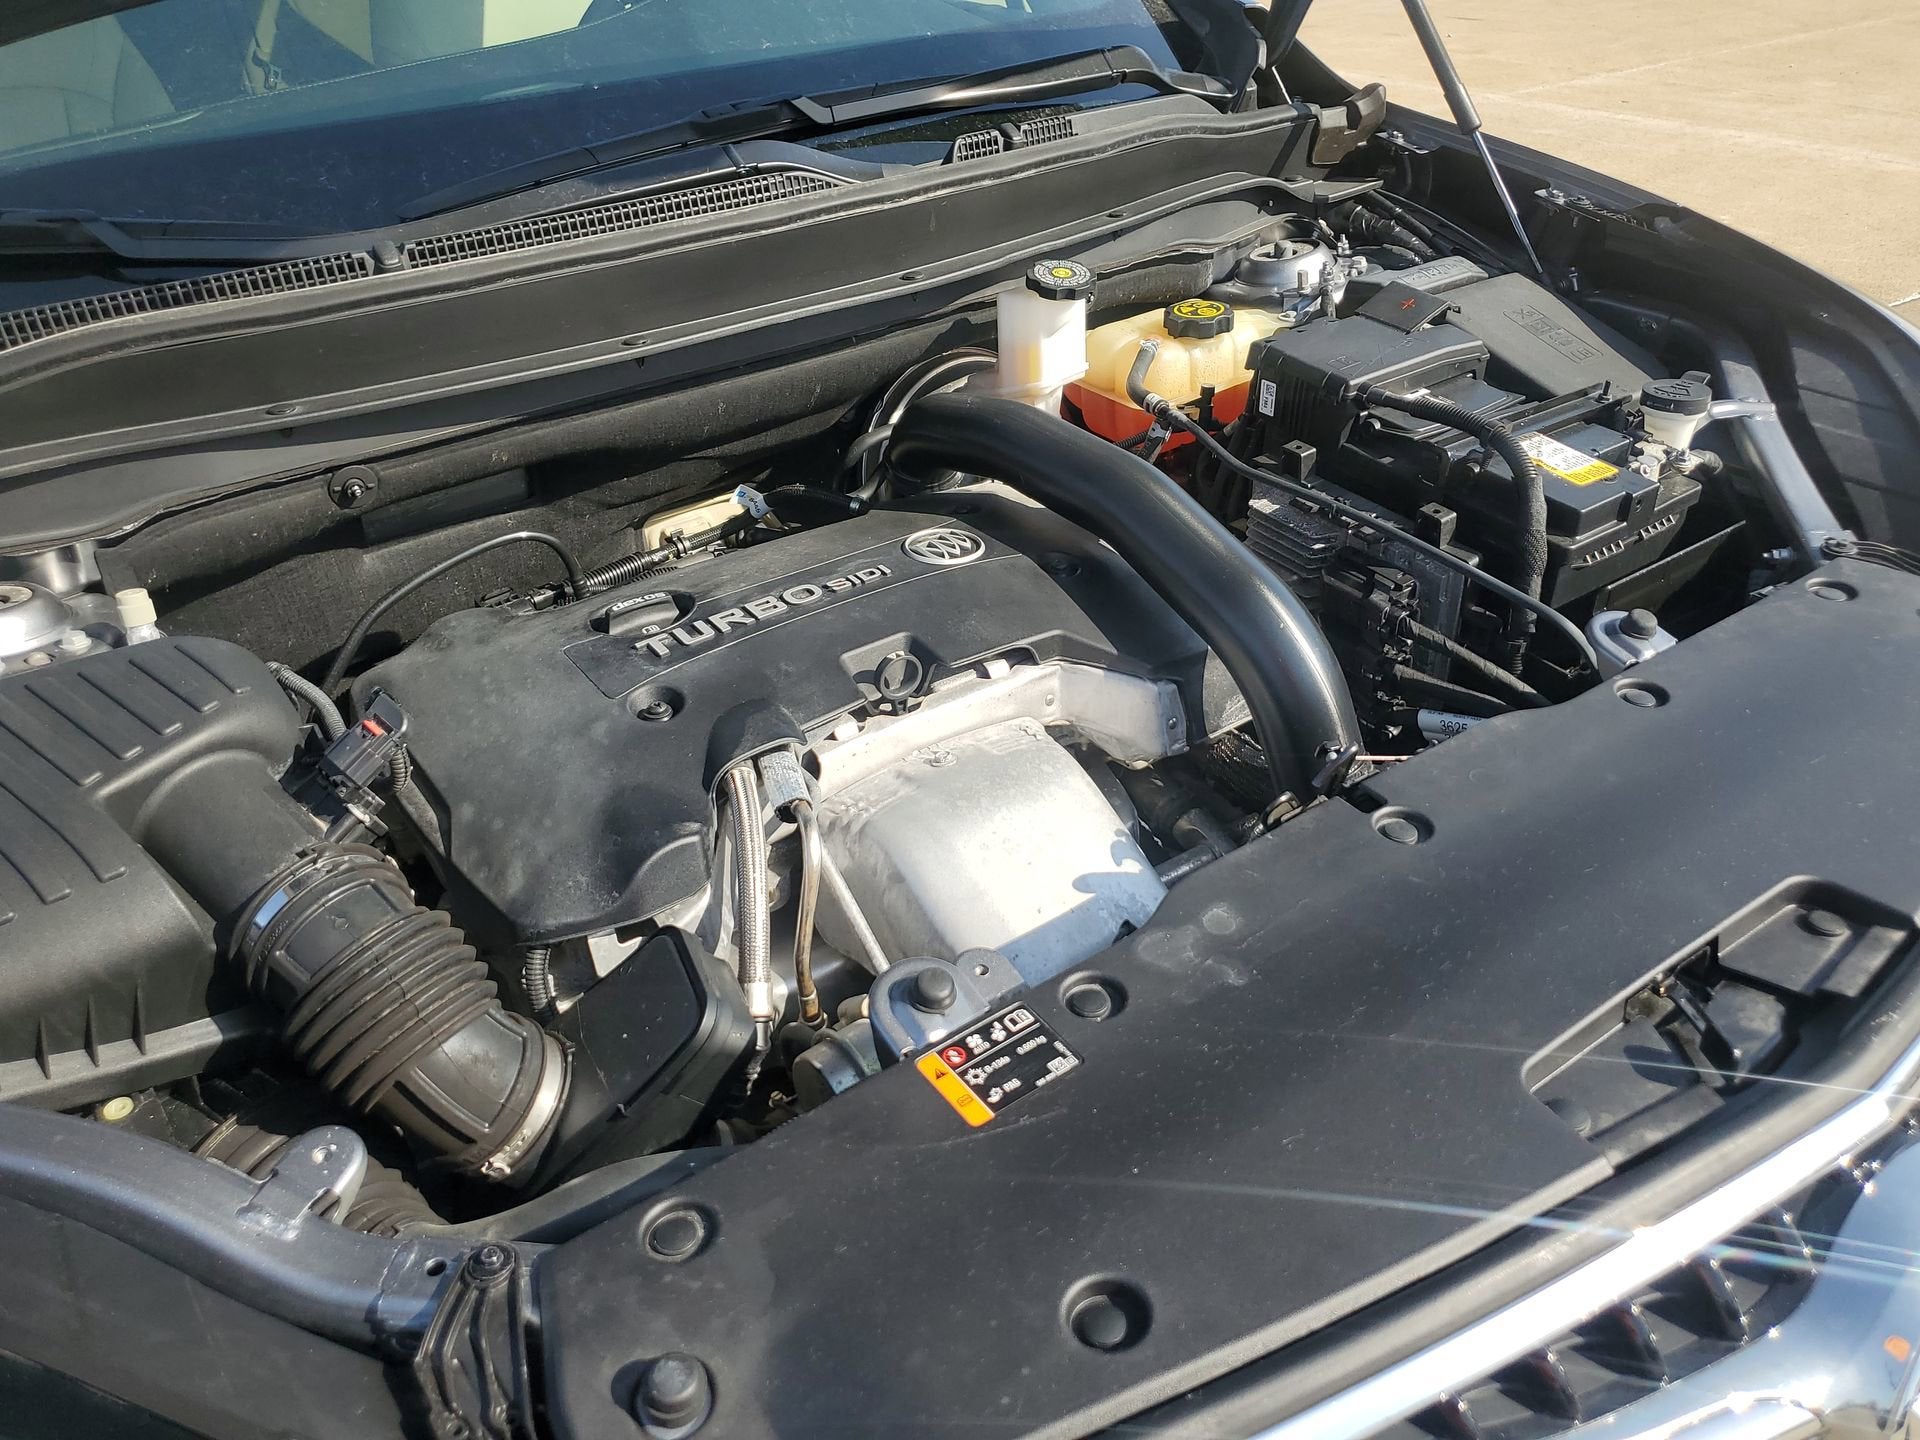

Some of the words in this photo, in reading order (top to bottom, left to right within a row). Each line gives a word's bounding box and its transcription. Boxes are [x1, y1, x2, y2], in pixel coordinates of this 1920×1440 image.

[612, 591, 666, 611] dexos
[634, 584, 823, 657] TURBO
[826, 564, 892, 592] SIDI
[973, 1041, 991, 1055] AUTO
[1016, 1039, 1038, 1055] 0.600
[1035, 1035, 1047, 1045] kg
[1002, 1078, 1022, 1092] PAG
